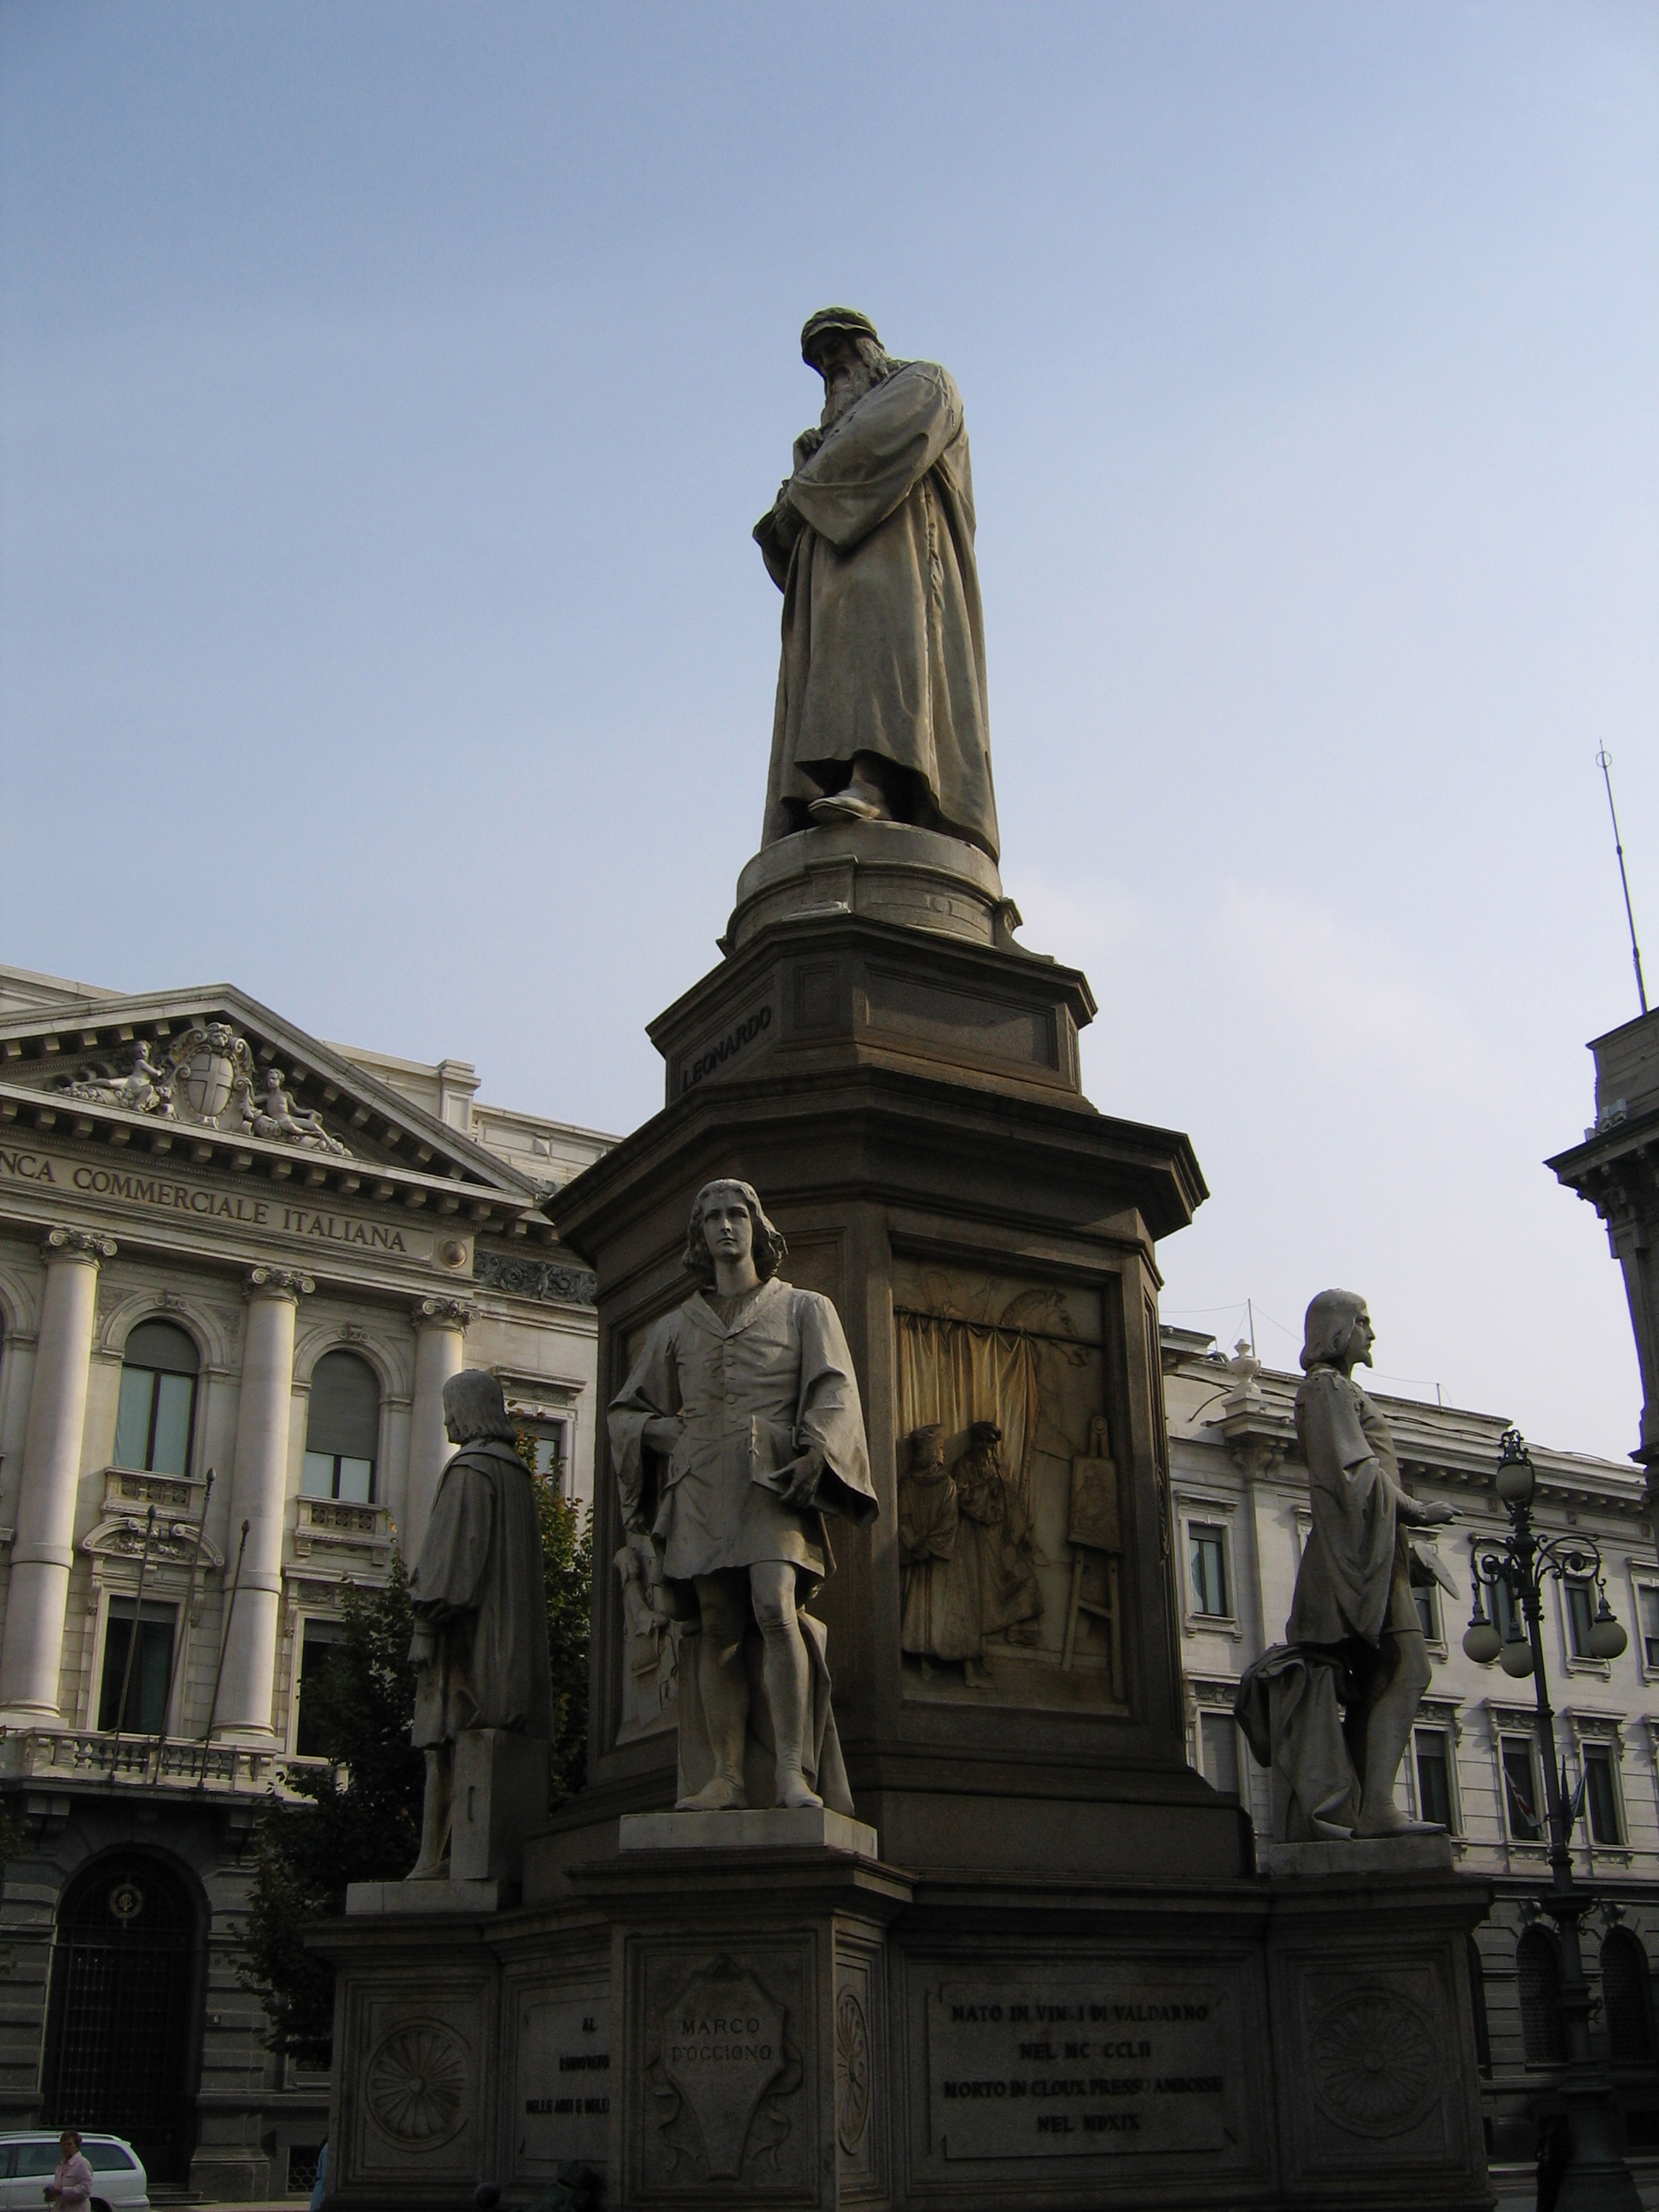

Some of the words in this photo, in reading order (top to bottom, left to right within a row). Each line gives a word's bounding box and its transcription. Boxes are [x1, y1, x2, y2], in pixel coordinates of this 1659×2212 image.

[682, 1005, 771, 1093] LEONARDO
[73, 1167, 270, 1225] COMMERCIALE
[282, 1208, 407, 1253] ITALIANA
[952, 2005, 1003, 2023] NATO
[1009, 2005, 1029, 2023] IN
[1035, 2005, 1085, 2023] VINI
[1091, 2005, 1109, 2022] DI
[1113, 2005, 1208, 2022] VALDARNO
[582, 2017, 598, 2032] AL
[682, 2017, 760, 2035] MARCO
[1019, 2041, 1057, 2060] NEL
[943, 2081, 1006, 2098] MORTO
[1010, 2081, 1027, 2098] IN
[1030, 2079, 1087, 2098] CLOUX
[1089, 2077, 1150, 2096] PRESSO
[1153, 2075, 1224, 2093] AMBOISE
[1037, 2115, 1075, 2133] NEL
[1082, 2113, 1142, 2133] MDXIX
